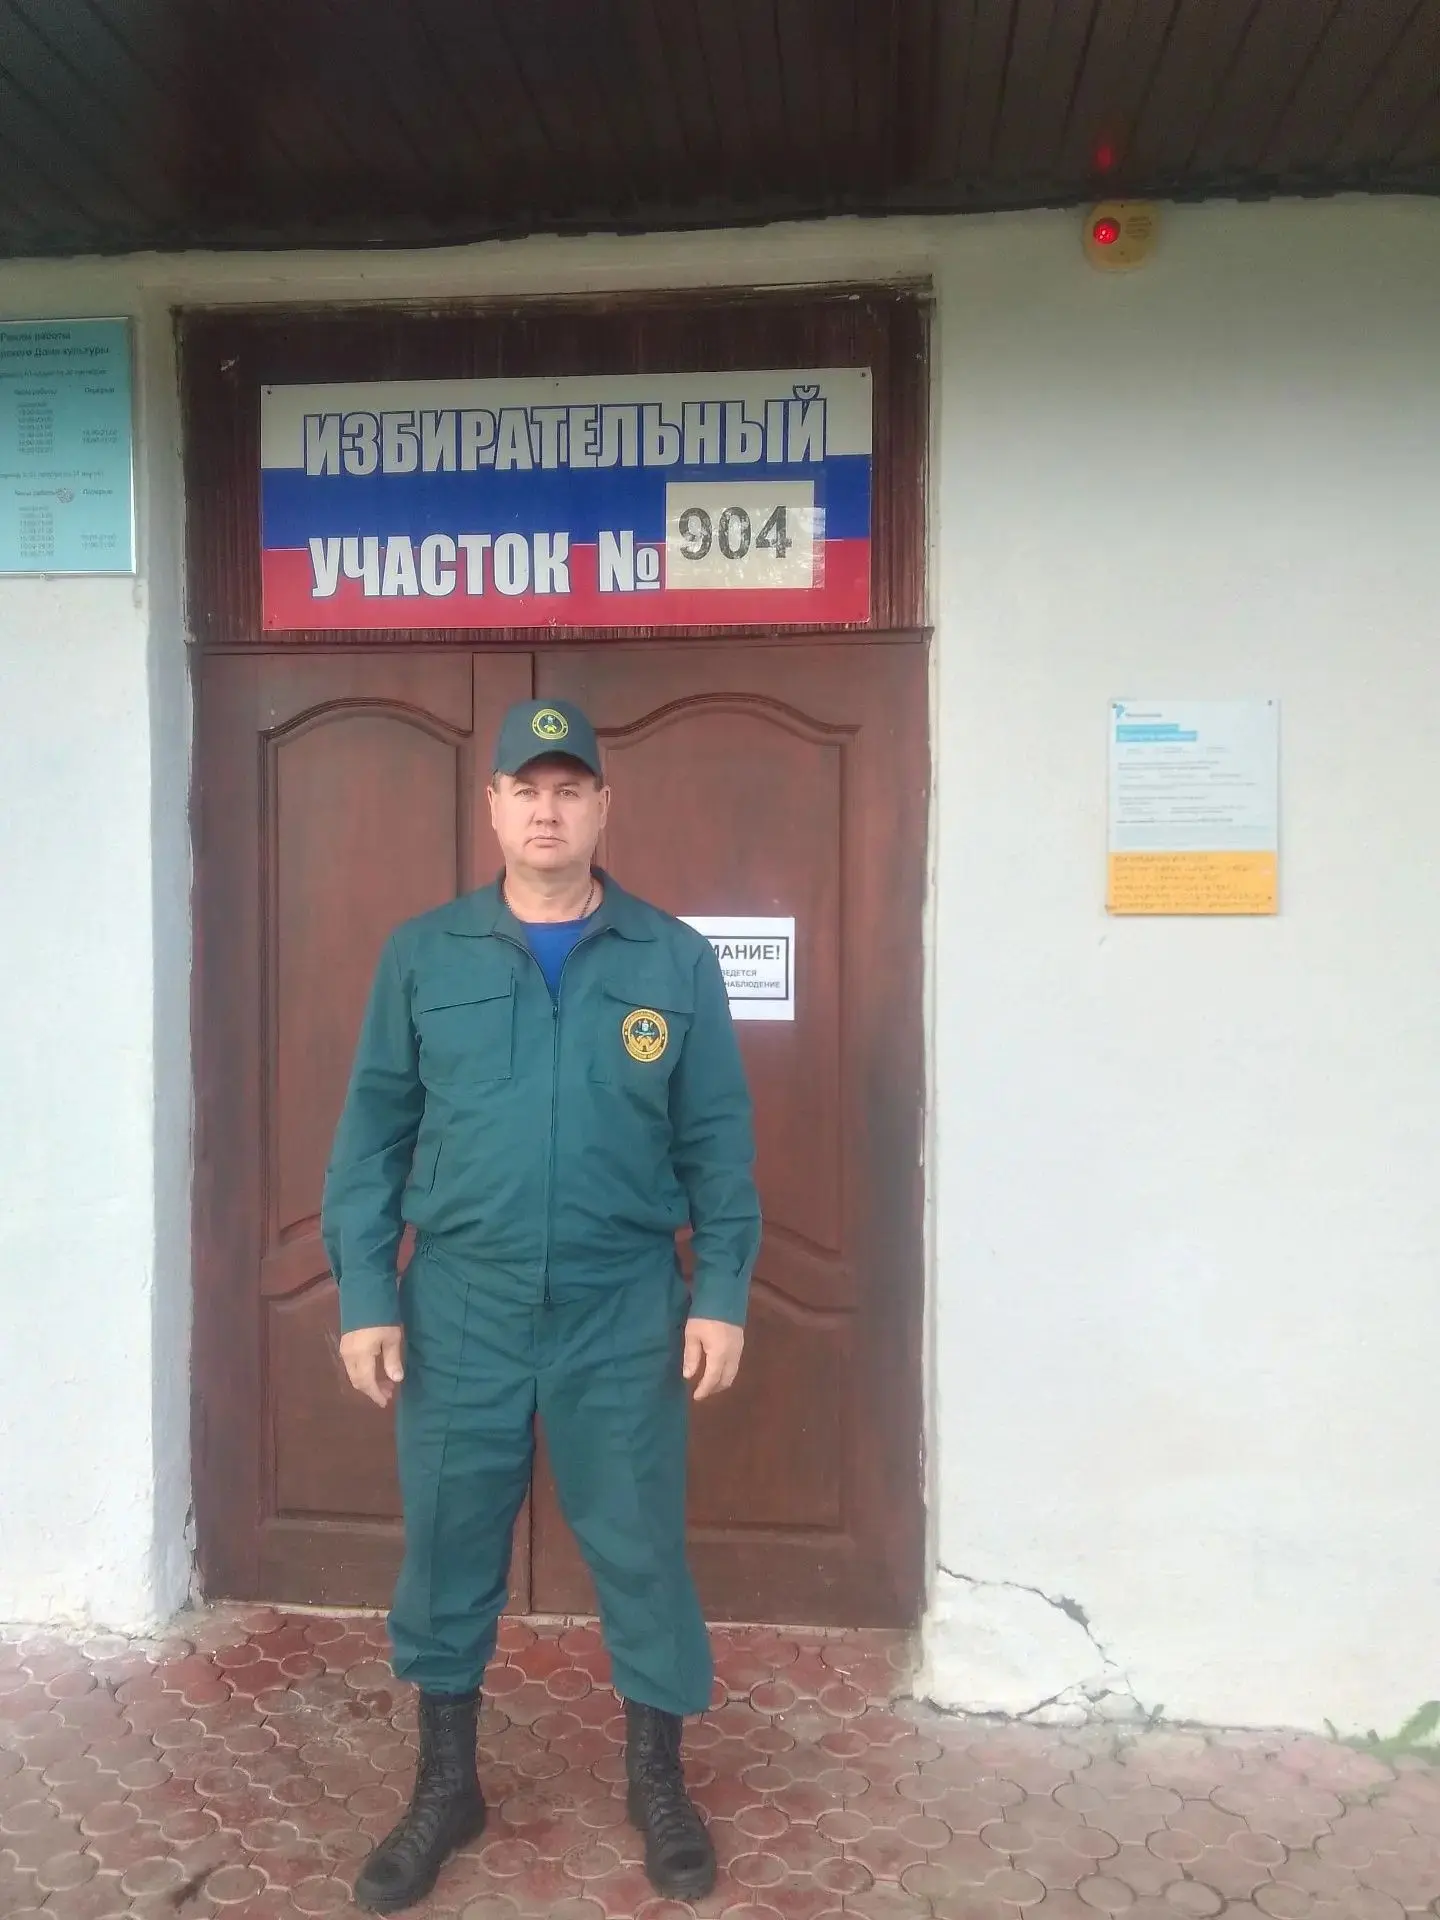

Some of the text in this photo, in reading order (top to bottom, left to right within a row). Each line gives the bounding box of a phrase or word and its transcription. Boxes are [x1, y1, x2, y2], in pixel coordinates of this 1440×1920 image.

[303, 385, 827, 476] ИЗБИРАТЕЛЬНЫЙ
[308, 505, 793, 598] УЧАСТОК № 904
